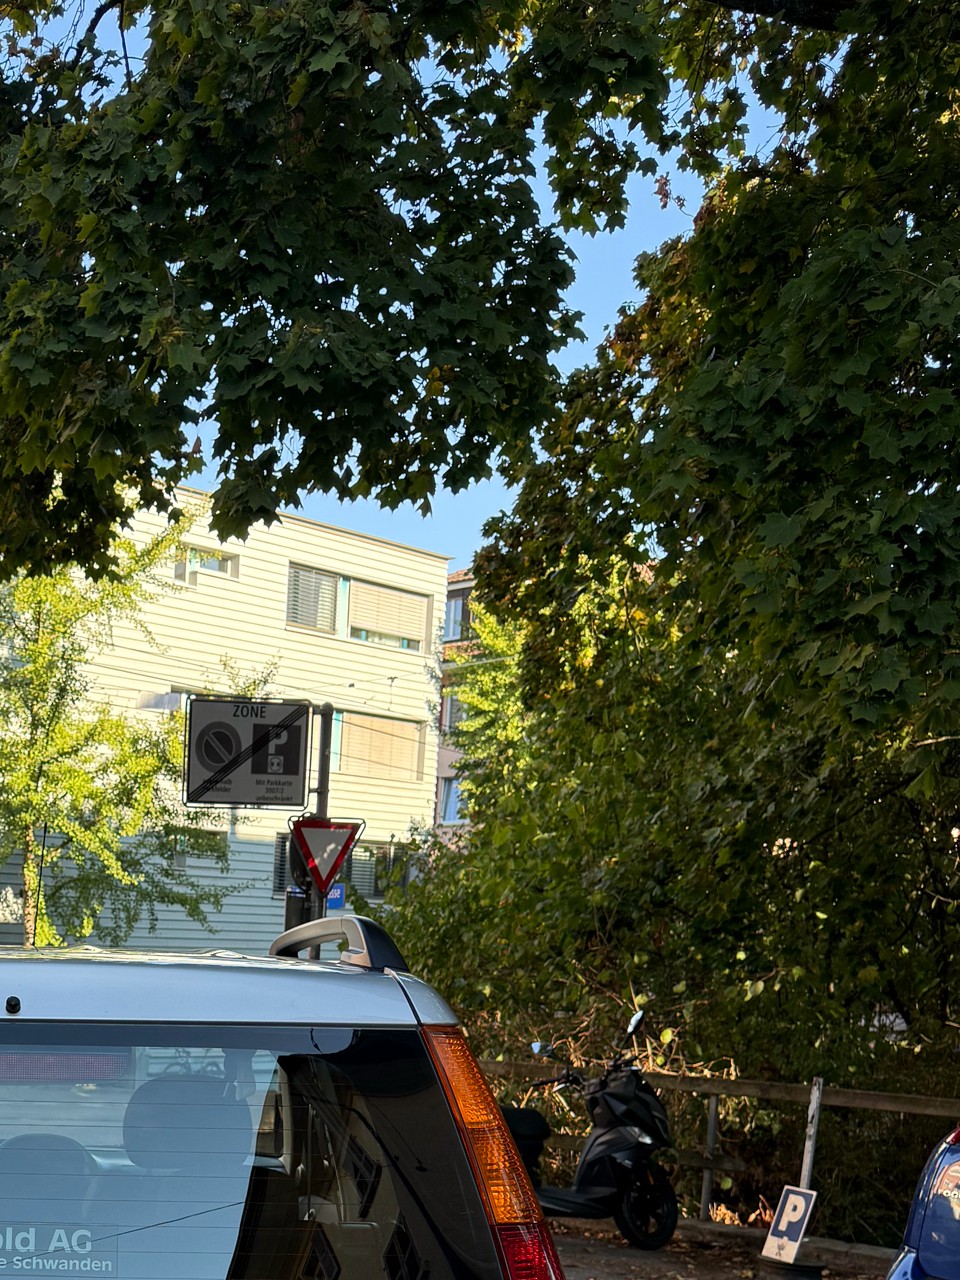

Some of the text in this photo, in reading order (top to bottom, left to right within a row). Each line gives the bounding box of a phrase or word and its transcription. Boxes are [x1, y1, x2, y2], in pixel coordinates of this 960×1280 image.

[233, 704, 267, 718] ZONE
[266, 779, 293, 787] Parkkarte
[778, 1193, 806, 1231] P
[48, 1228, 92, 1254] AG
[12, 1255, 113, 1272] Schwanden
